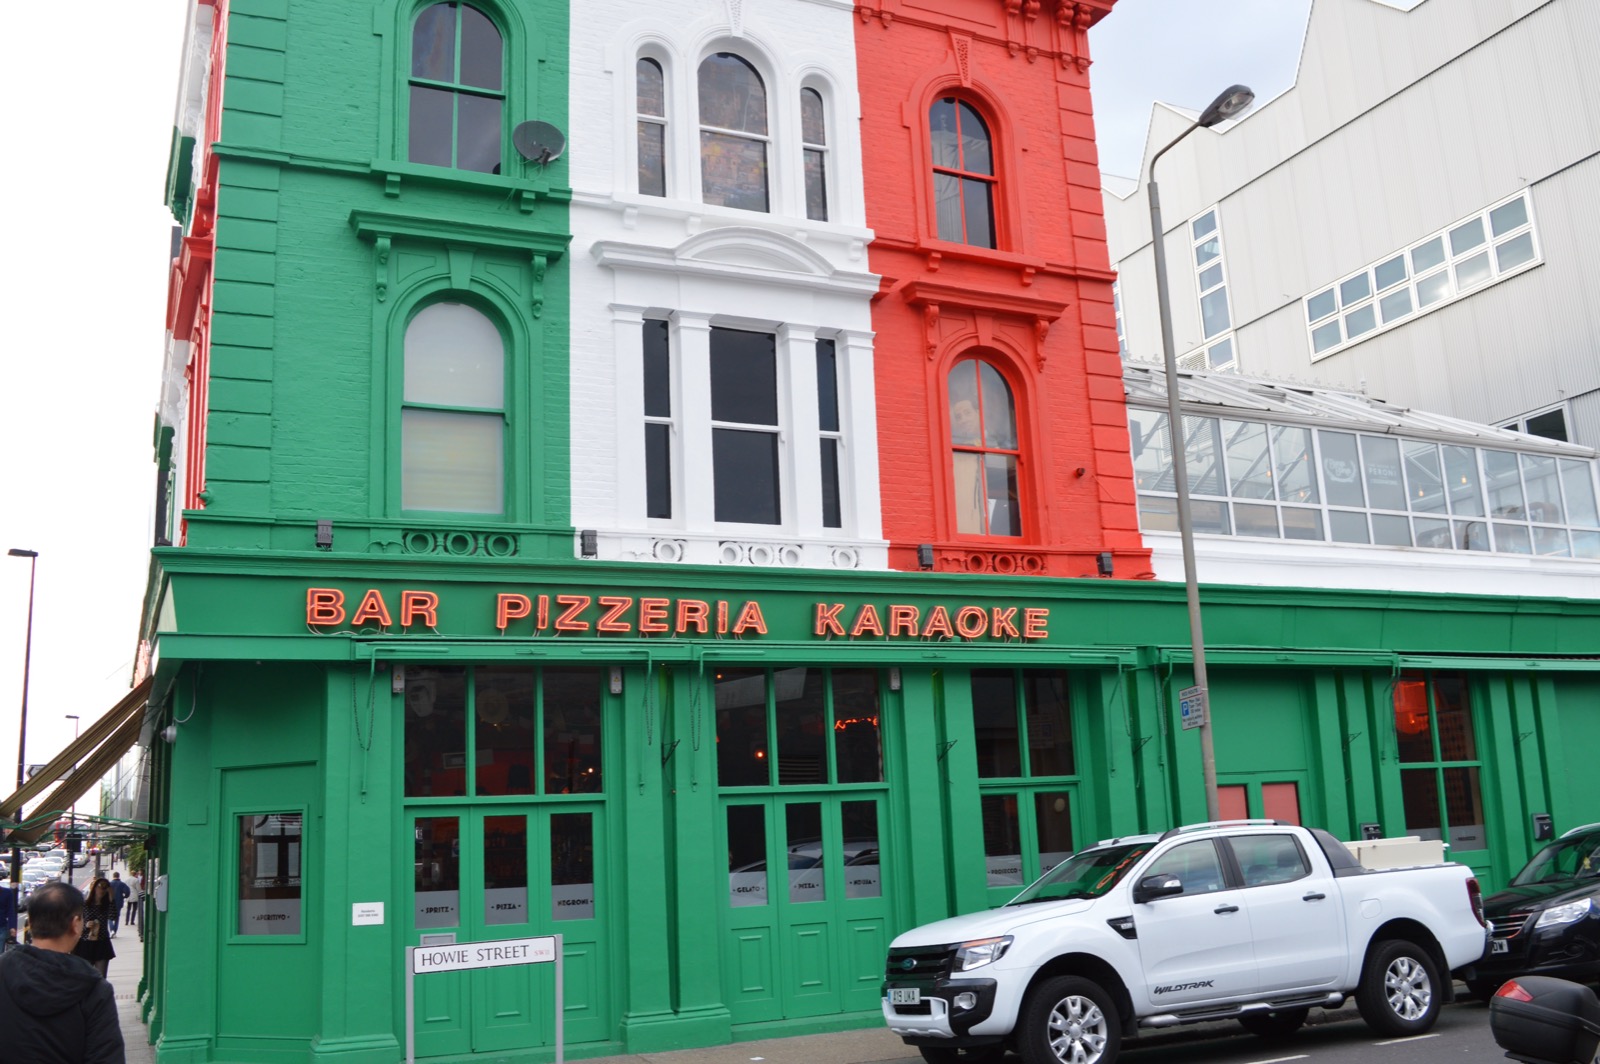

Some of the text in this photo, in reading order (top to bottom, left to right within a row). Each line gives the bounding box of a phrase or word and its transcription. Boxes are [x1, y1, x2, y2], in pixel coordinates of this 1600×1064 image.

[306, 588, 1050, 638] BAR PIZZERIA KARAOKE
[557, 898, 589, 907] NEGRONI
[425, 906, 450, 914] SPRITZ
[256, 913, 286, 921] APERITIVO
[421, 949, 469, 966] HOWIE
[476, 944, 530, 962] STREET
[1153, 979, 1215, 995] WILDTRAK
